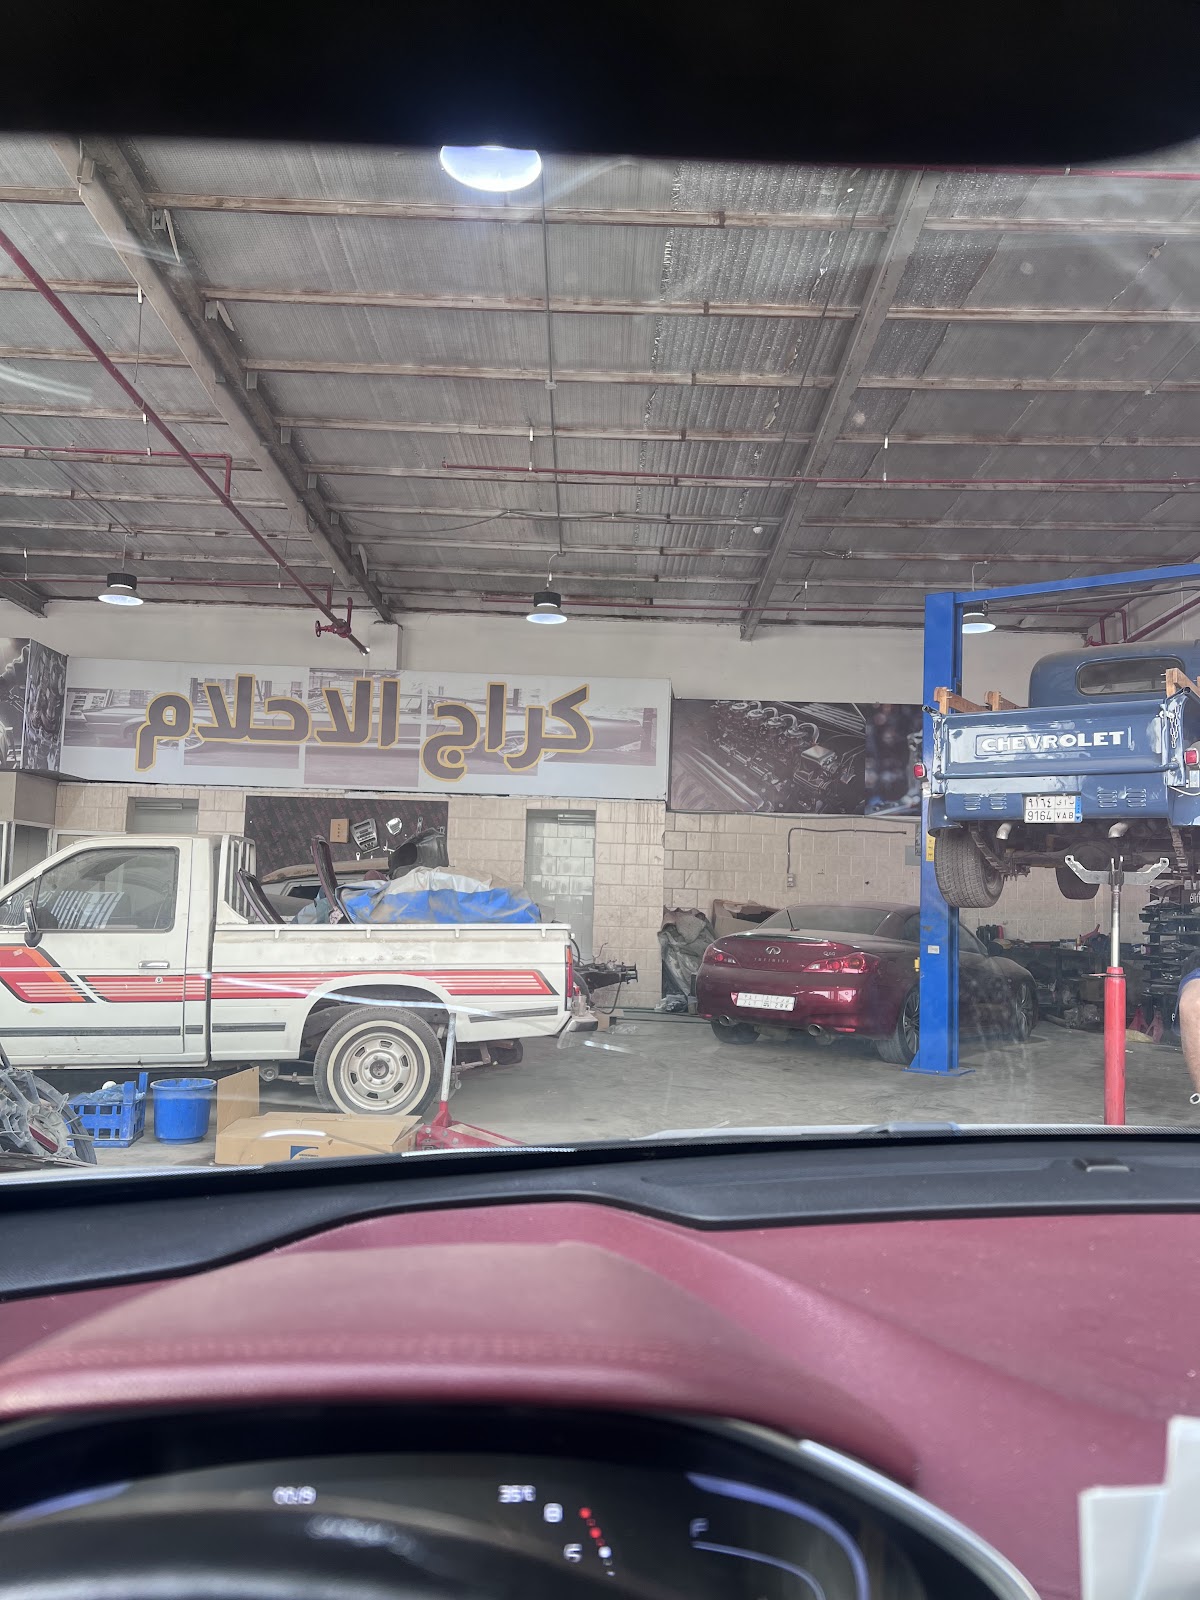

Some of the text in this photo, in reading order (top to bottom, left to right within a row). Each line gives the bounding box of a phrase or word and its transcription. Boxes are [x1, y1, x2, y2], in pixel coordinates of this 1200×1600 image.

[135, 672, 595, 781] كراج الاحلام
[981, 730, 1125, 751] CHEVROLET
[1027, 810, 1074, 821] 9164 VAB
